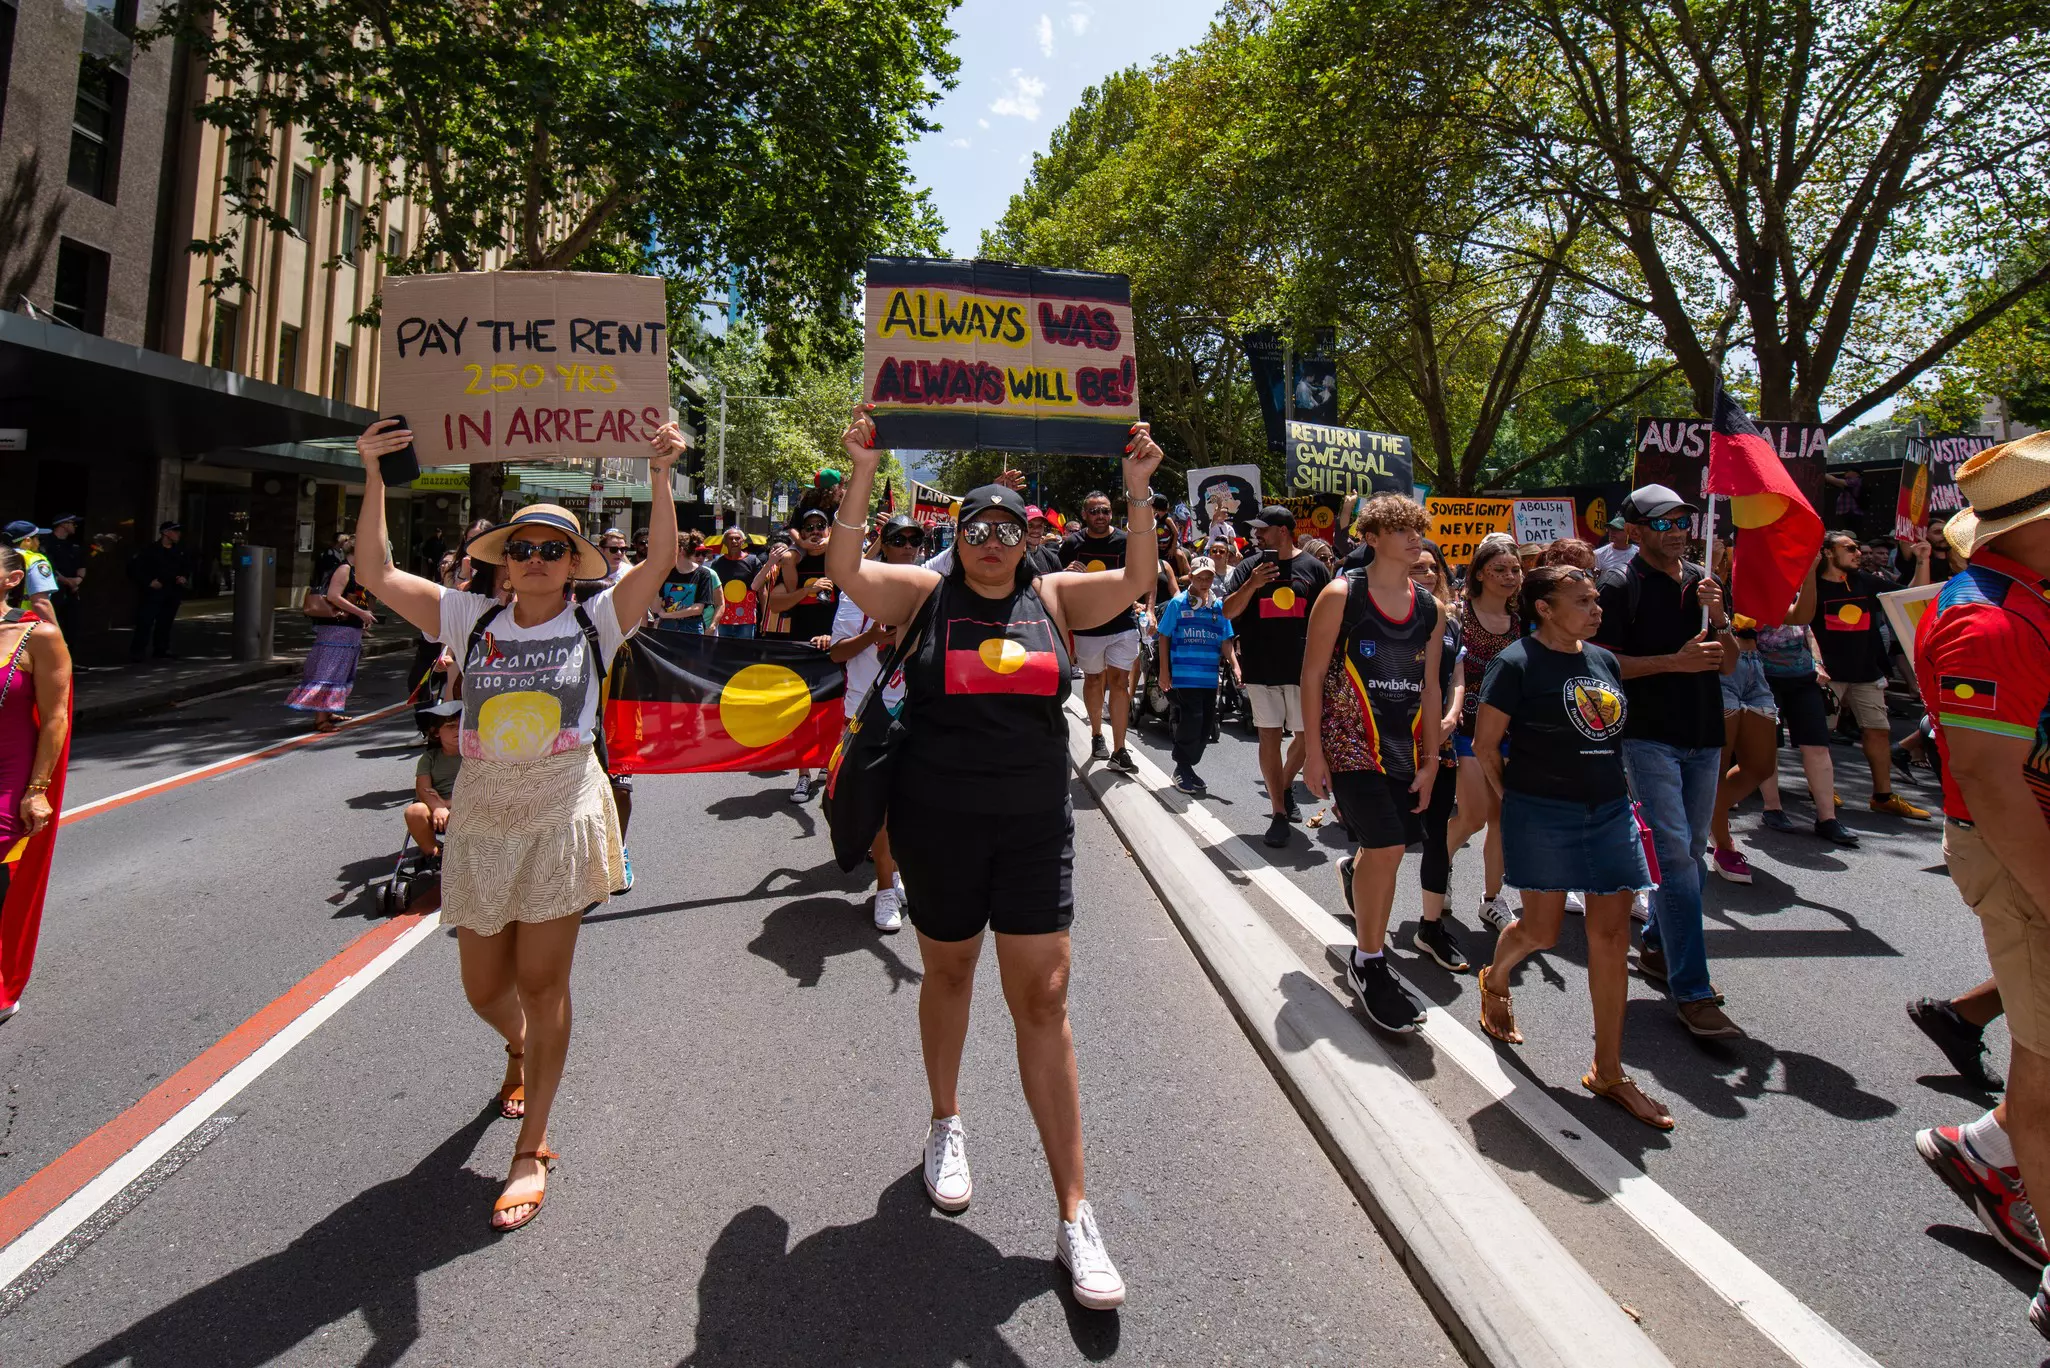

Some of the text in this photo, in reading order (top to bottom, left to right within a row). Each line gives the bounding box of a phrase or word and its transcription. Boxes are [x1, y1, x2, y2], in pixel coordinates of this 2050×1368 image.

[881, 289, 1120, 349] ALWAYS WAS
[397, 316, 666, 358] PAY THE RENT
[463, 363, 617, 395] 250 YRS
[874, 356, 1134, 405] ALWAYS WILL BE!
[445, 406, 661, 450] IN ARREARS
[1291, 423, 1406, 456] RETURN THE
[1638, 420, 1829, 459] AUSALIA
[1296, 443, 1394, 477] GWEAGAL
[918, 486, 951, 504] LAND
[1520, 502, 1563, 513] ABOLISH
[1430, 502, 1511, 516] SOVEREIGNTY
[1533, 517, 1553, 527] The
[1440, 523, 1495, 535] NEVER
[1525, 529, 1558, 542] DATE
[1183, 628, 1206, 638] Mint
[468, 643, 584, 669] Dreaming
[552, 674, 589, 690] years
